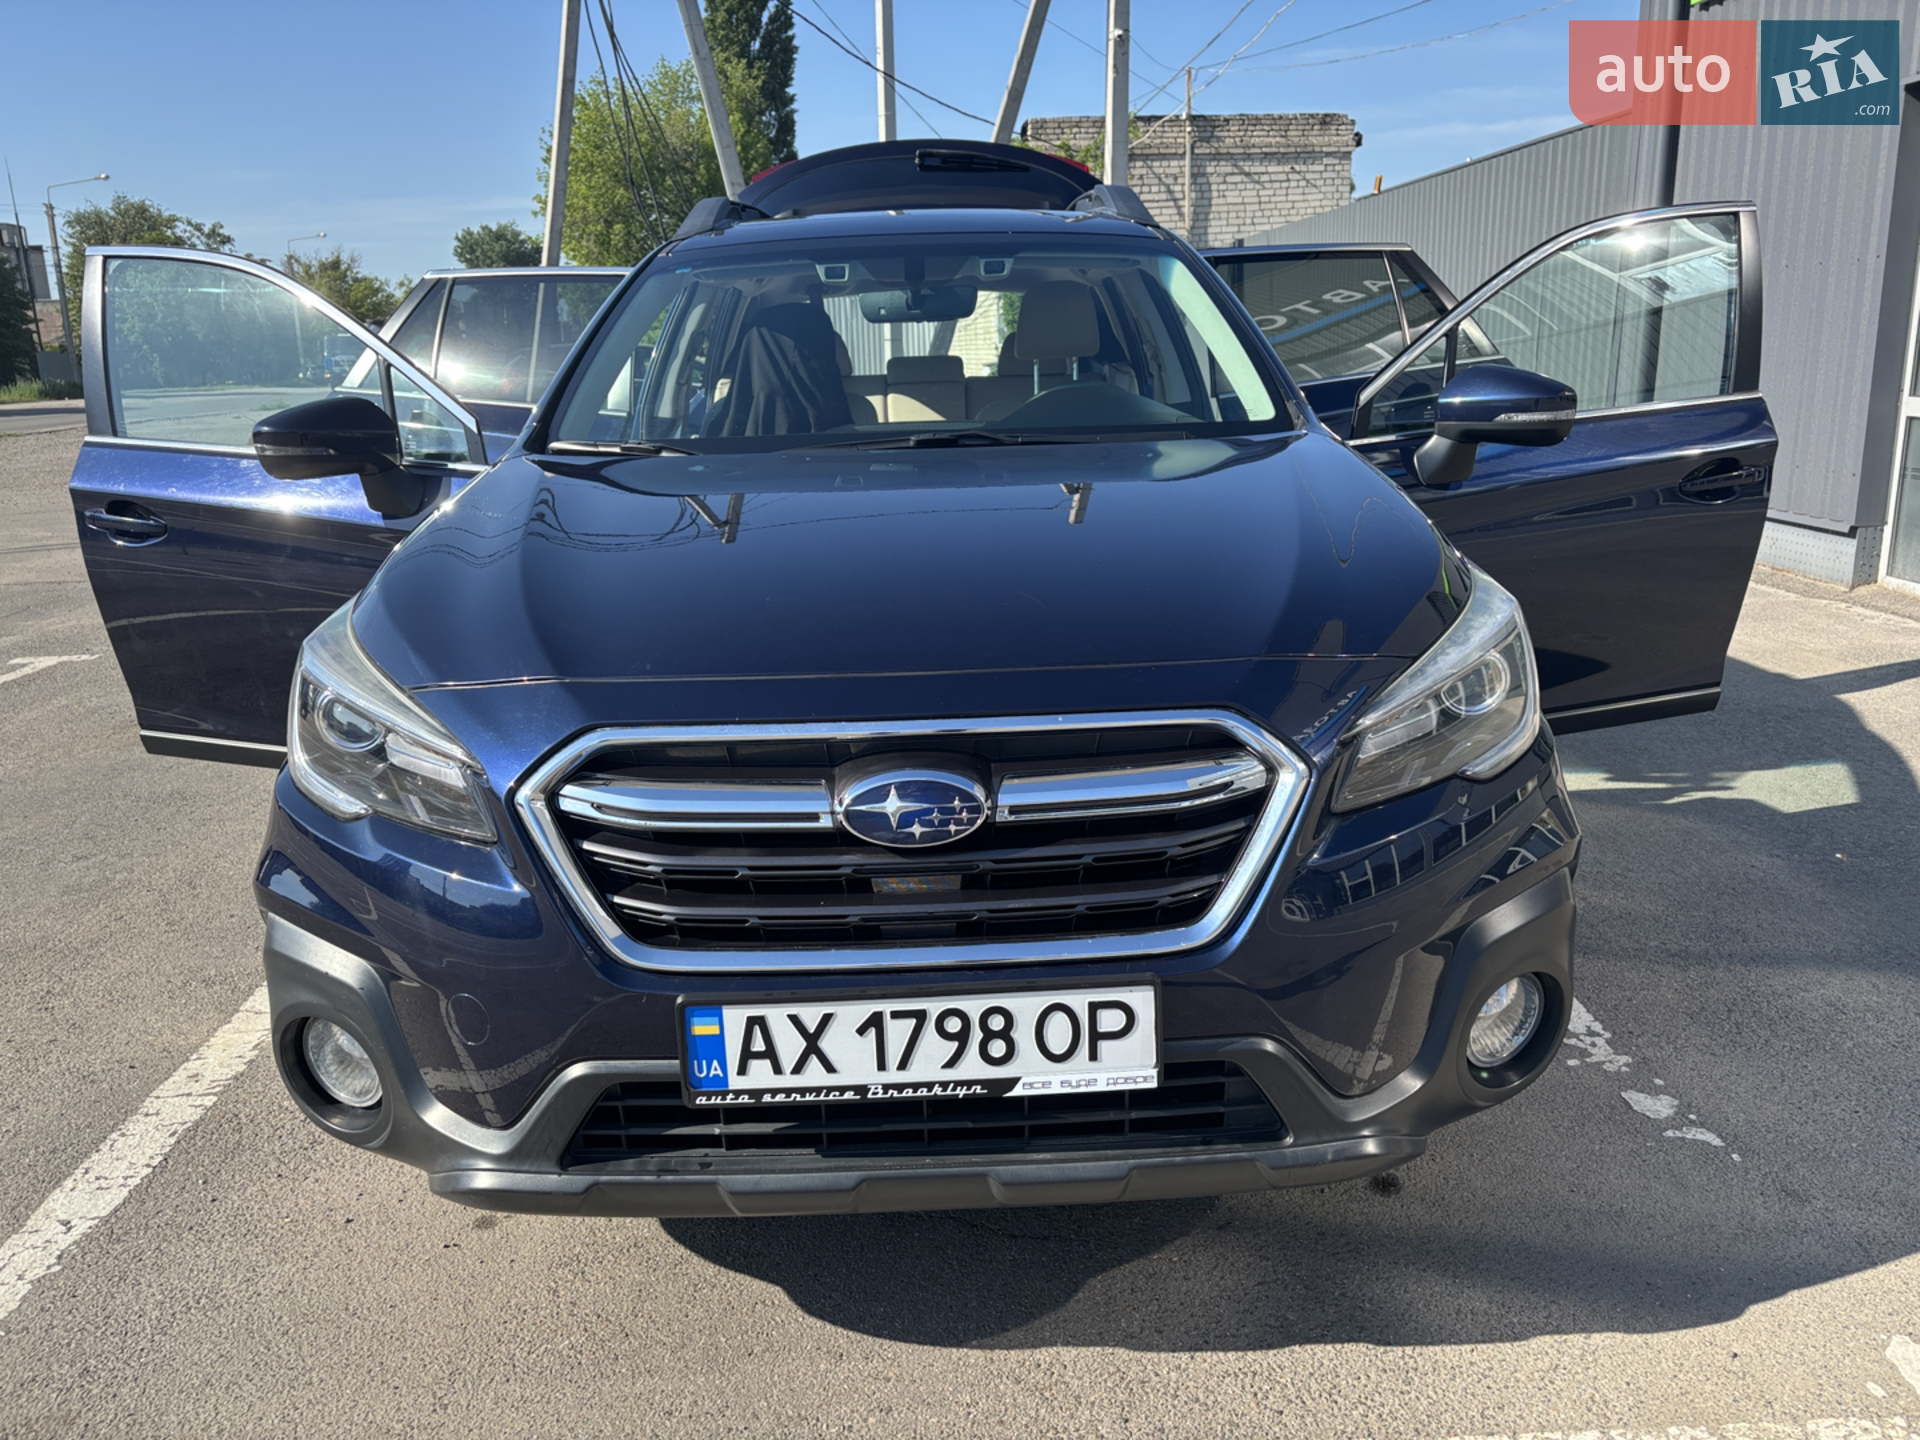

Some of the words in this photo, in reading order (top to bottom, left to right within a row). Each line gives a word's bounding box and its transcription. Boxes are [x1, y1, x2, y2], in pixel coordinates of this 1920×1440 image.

[736, 1012, 839, 1077] AX
[855, 1005, 1016, 1072] 1798
[1034, 999, 1136, 1064] OP
[693, 1059, 724, 1078] UA
[695, 1092, 756, 1105] auto
[761, 1088, 862, 1102] service
[866, 1083, 988, 1099] Brooklyn
